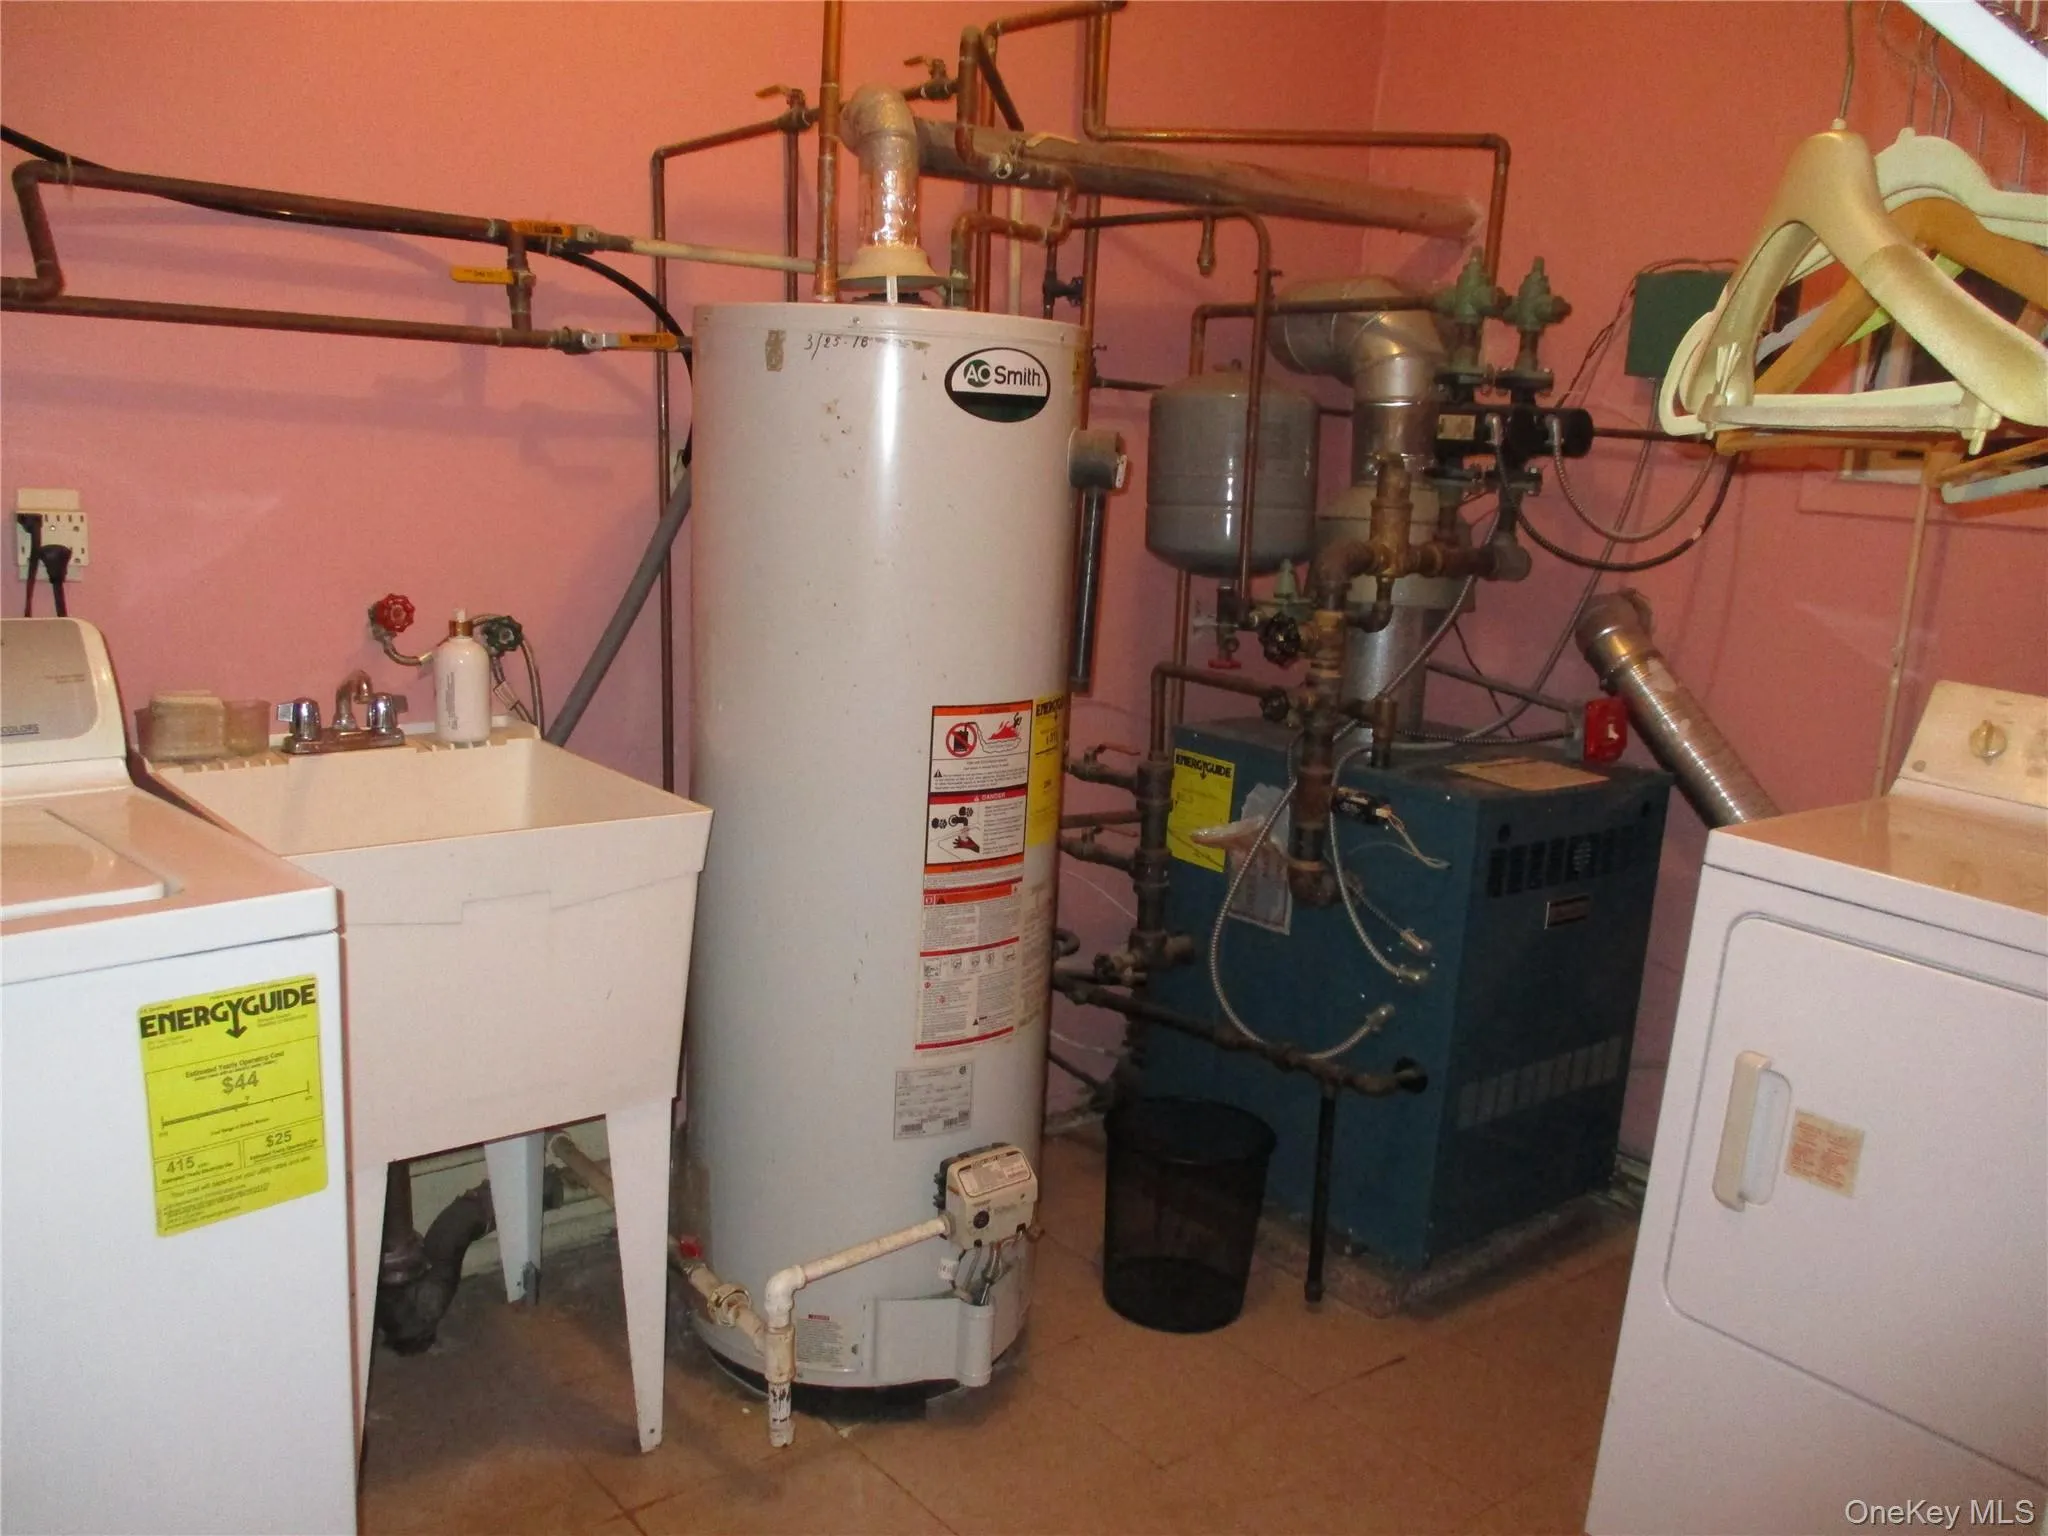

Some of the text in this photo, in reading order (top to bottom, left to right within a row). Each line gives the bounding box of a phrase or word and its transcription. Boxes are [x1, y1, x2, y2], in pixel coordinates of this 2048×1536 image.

[994, 365, 1041, 387] Smith
[140, 984, 316, 1039] ENERGYGUIDE
[222, 1070, 259, 1095] $44
[265, 1130, 292, 1148] $25
[165, 1156, 195, 1174] 415
